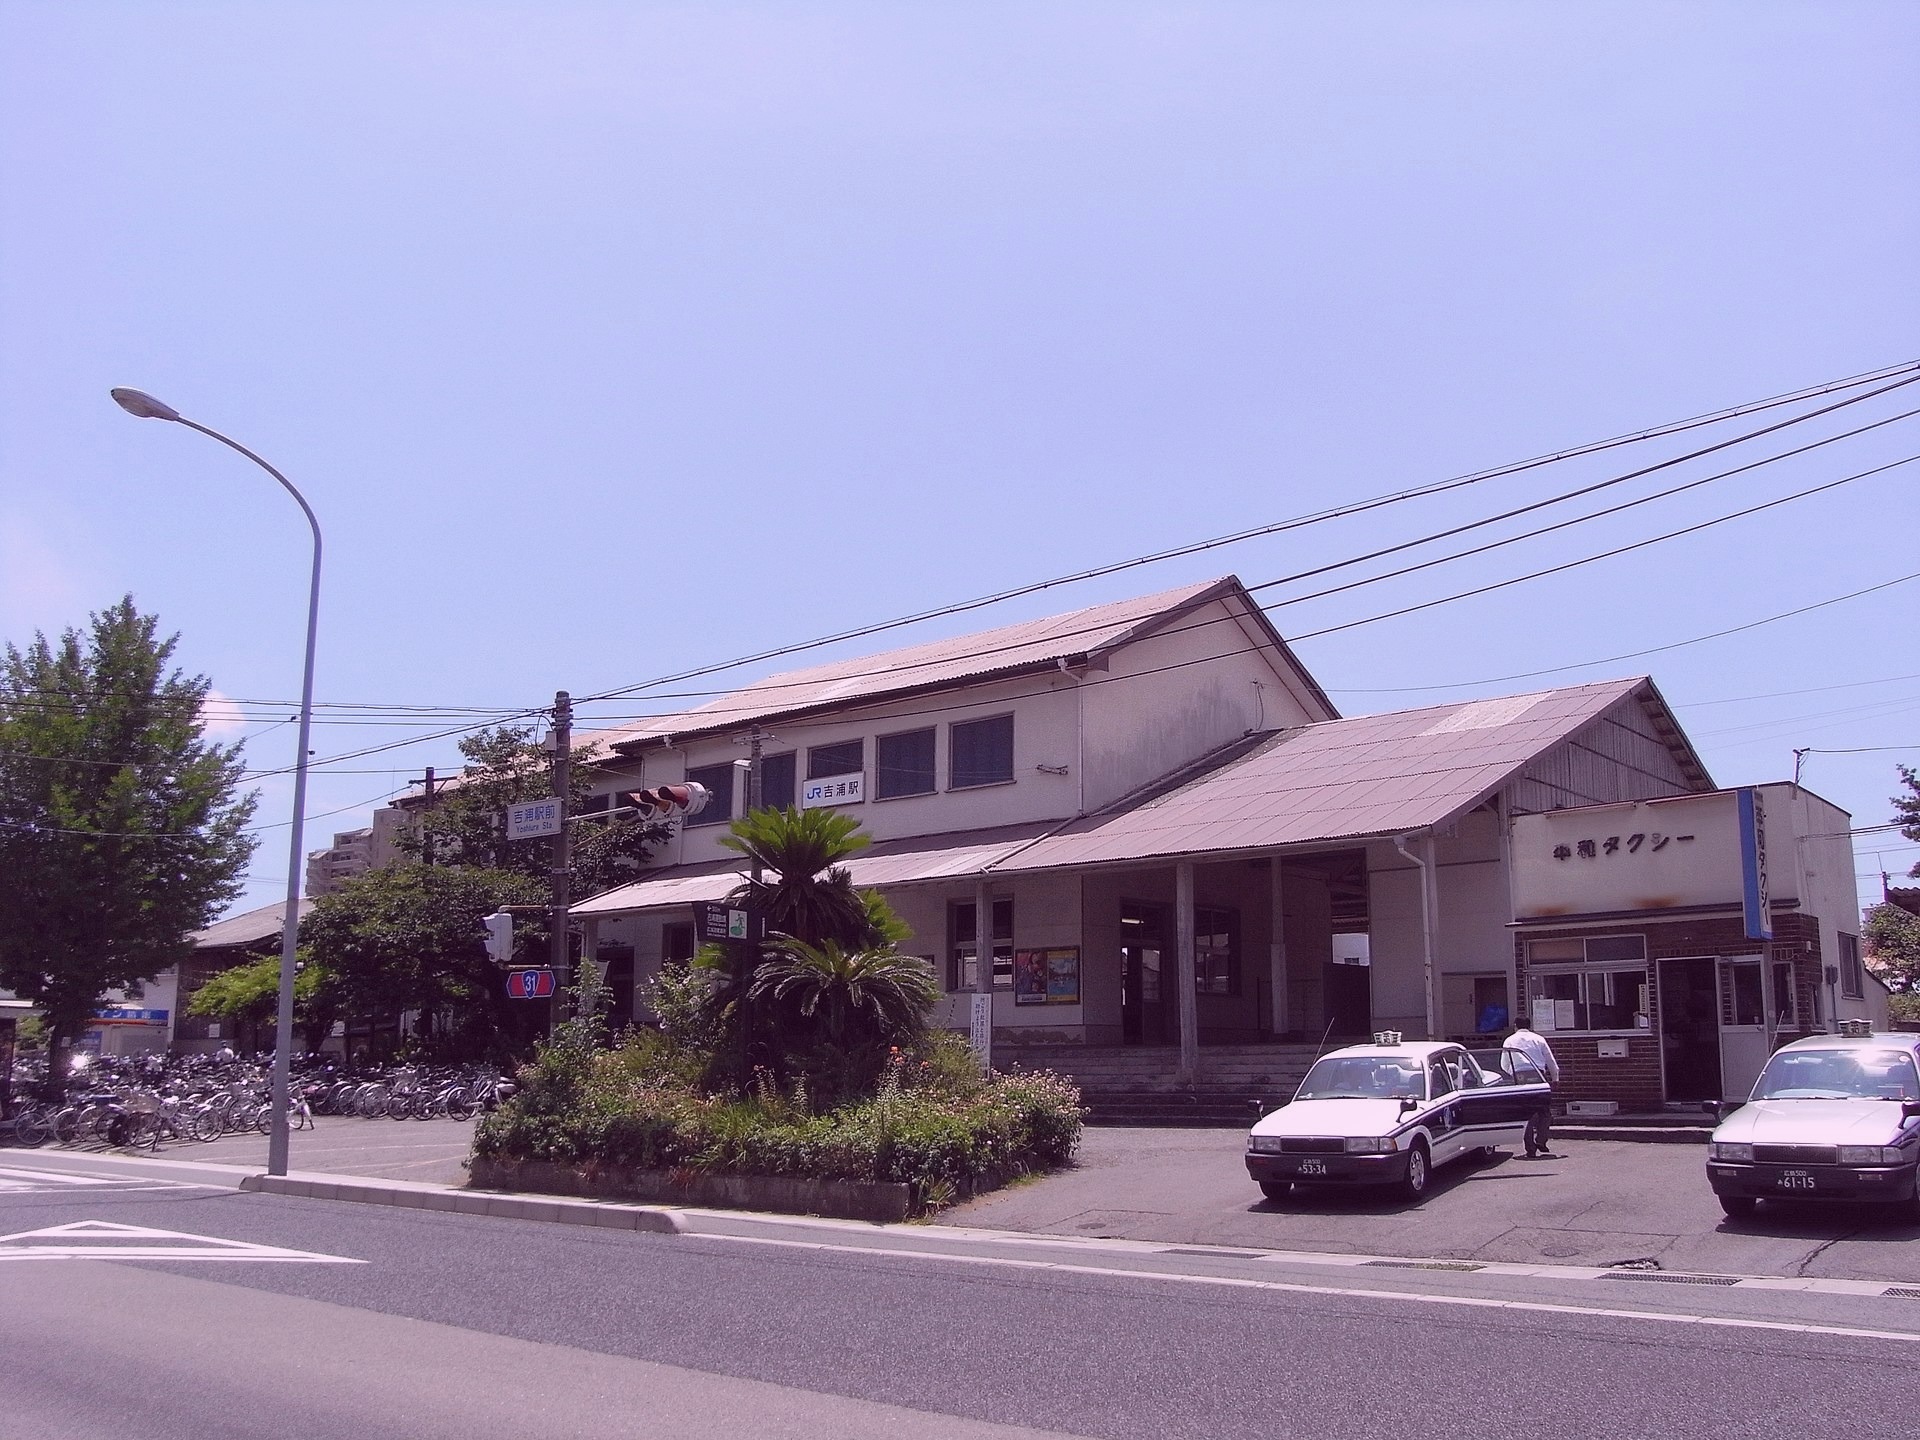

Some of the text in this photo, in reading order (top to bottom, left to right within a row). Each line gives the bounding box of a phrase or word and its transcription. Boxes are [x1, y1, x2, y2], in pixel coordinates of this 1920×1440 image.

[807, 780, 859, 800] JR 吉浦駅
[513, 804, 555, 824] 吉浦駅前
[525, 975, 536, 992] 31
[1302, 1164, 1327, 1175] 53-34
[1783, 1176, 1815, 1188] 61-15
